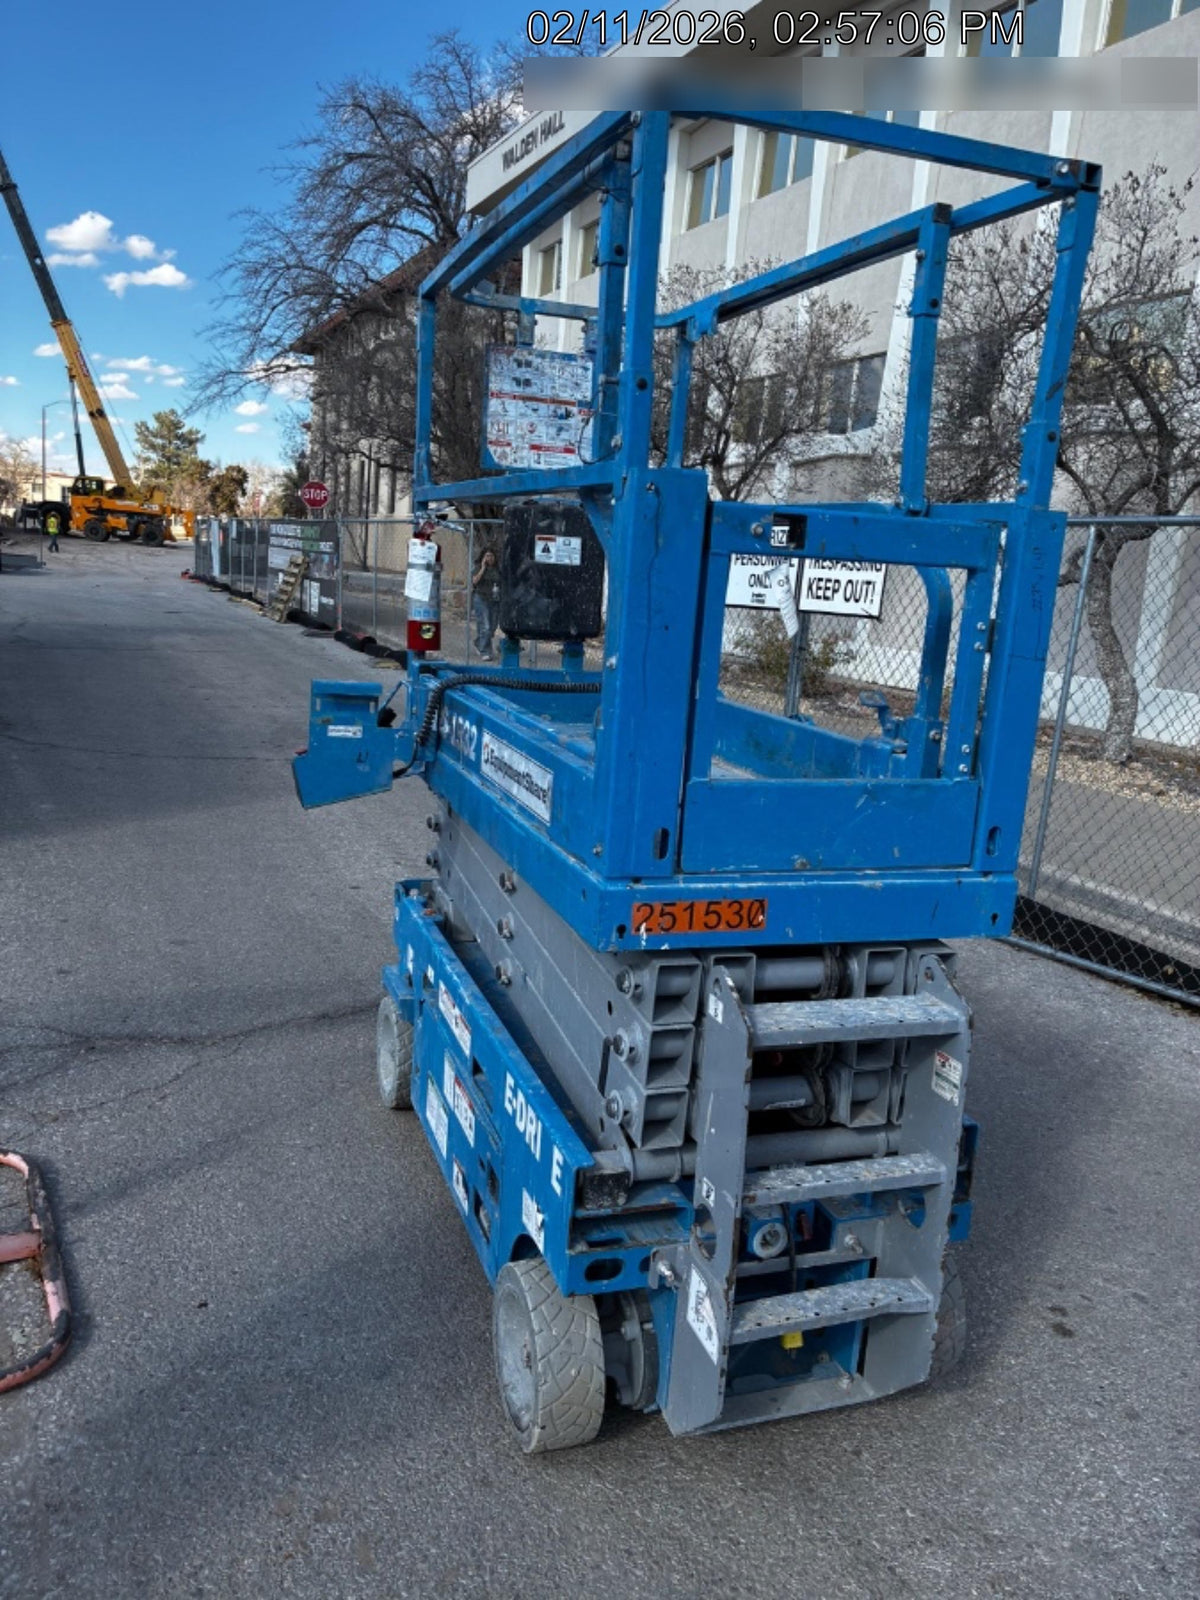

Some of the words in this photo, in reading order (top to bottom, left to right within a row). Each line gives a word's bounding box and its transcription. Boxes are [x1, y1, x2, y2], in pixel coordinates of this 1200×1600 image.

[502, 128, 540, 172] WALDEN
[540, 111, 566, 145] HALL
[303, 488, 328, 501] STOP
[748, 573, 772, 589] ONL
[806, 577, 841, 601] KEEP
[843, 579, 877, 604] OUT!
[634, 899, 766, 933] 251530
